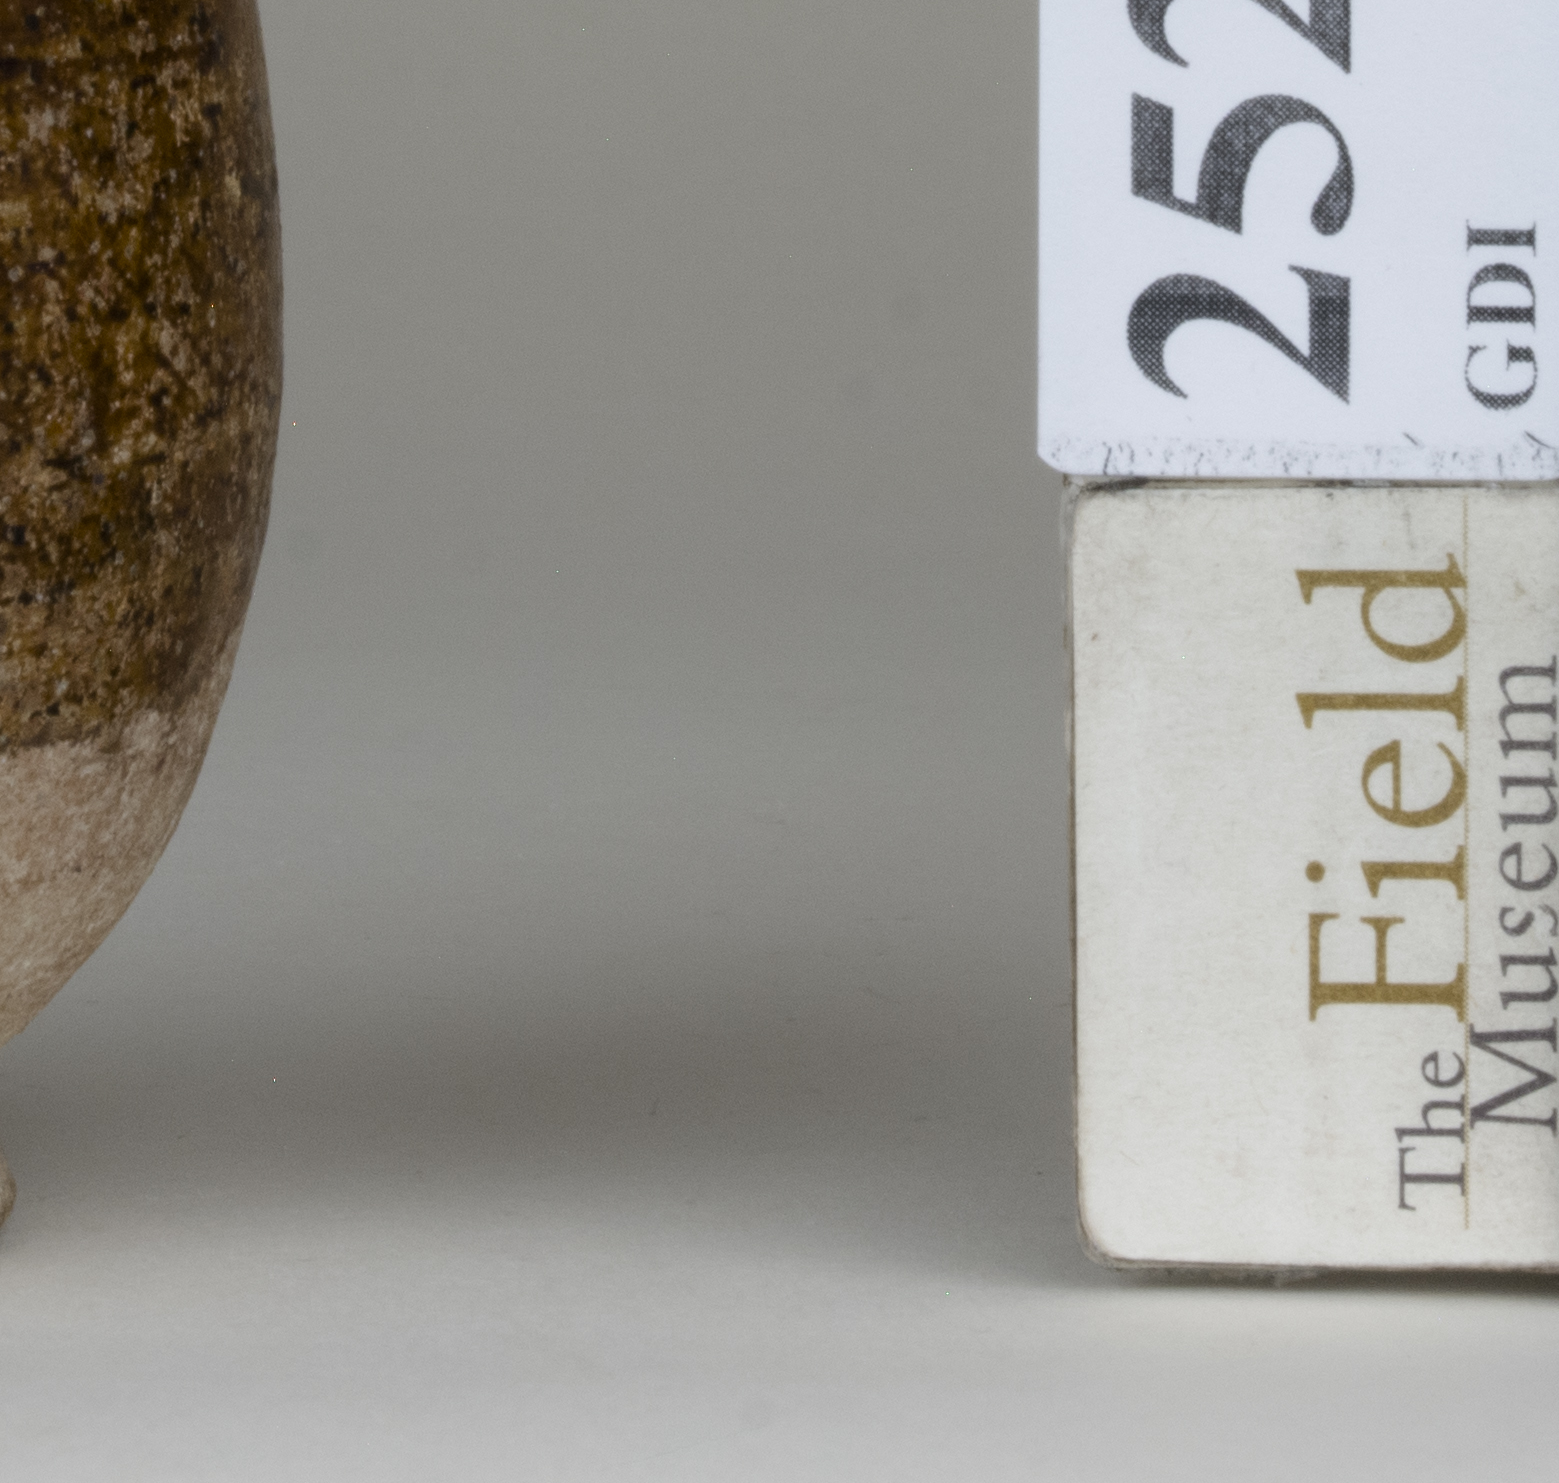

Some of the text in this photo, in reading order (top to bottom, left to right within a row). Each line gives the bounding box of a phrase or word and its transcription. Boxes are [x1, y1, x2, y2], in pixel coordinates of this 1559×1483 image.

[1465, 218, 1538, 412] GDI
[1295, 551, 1468, 1212] The Field
[1469, 654, 1559, 1139] Museum
